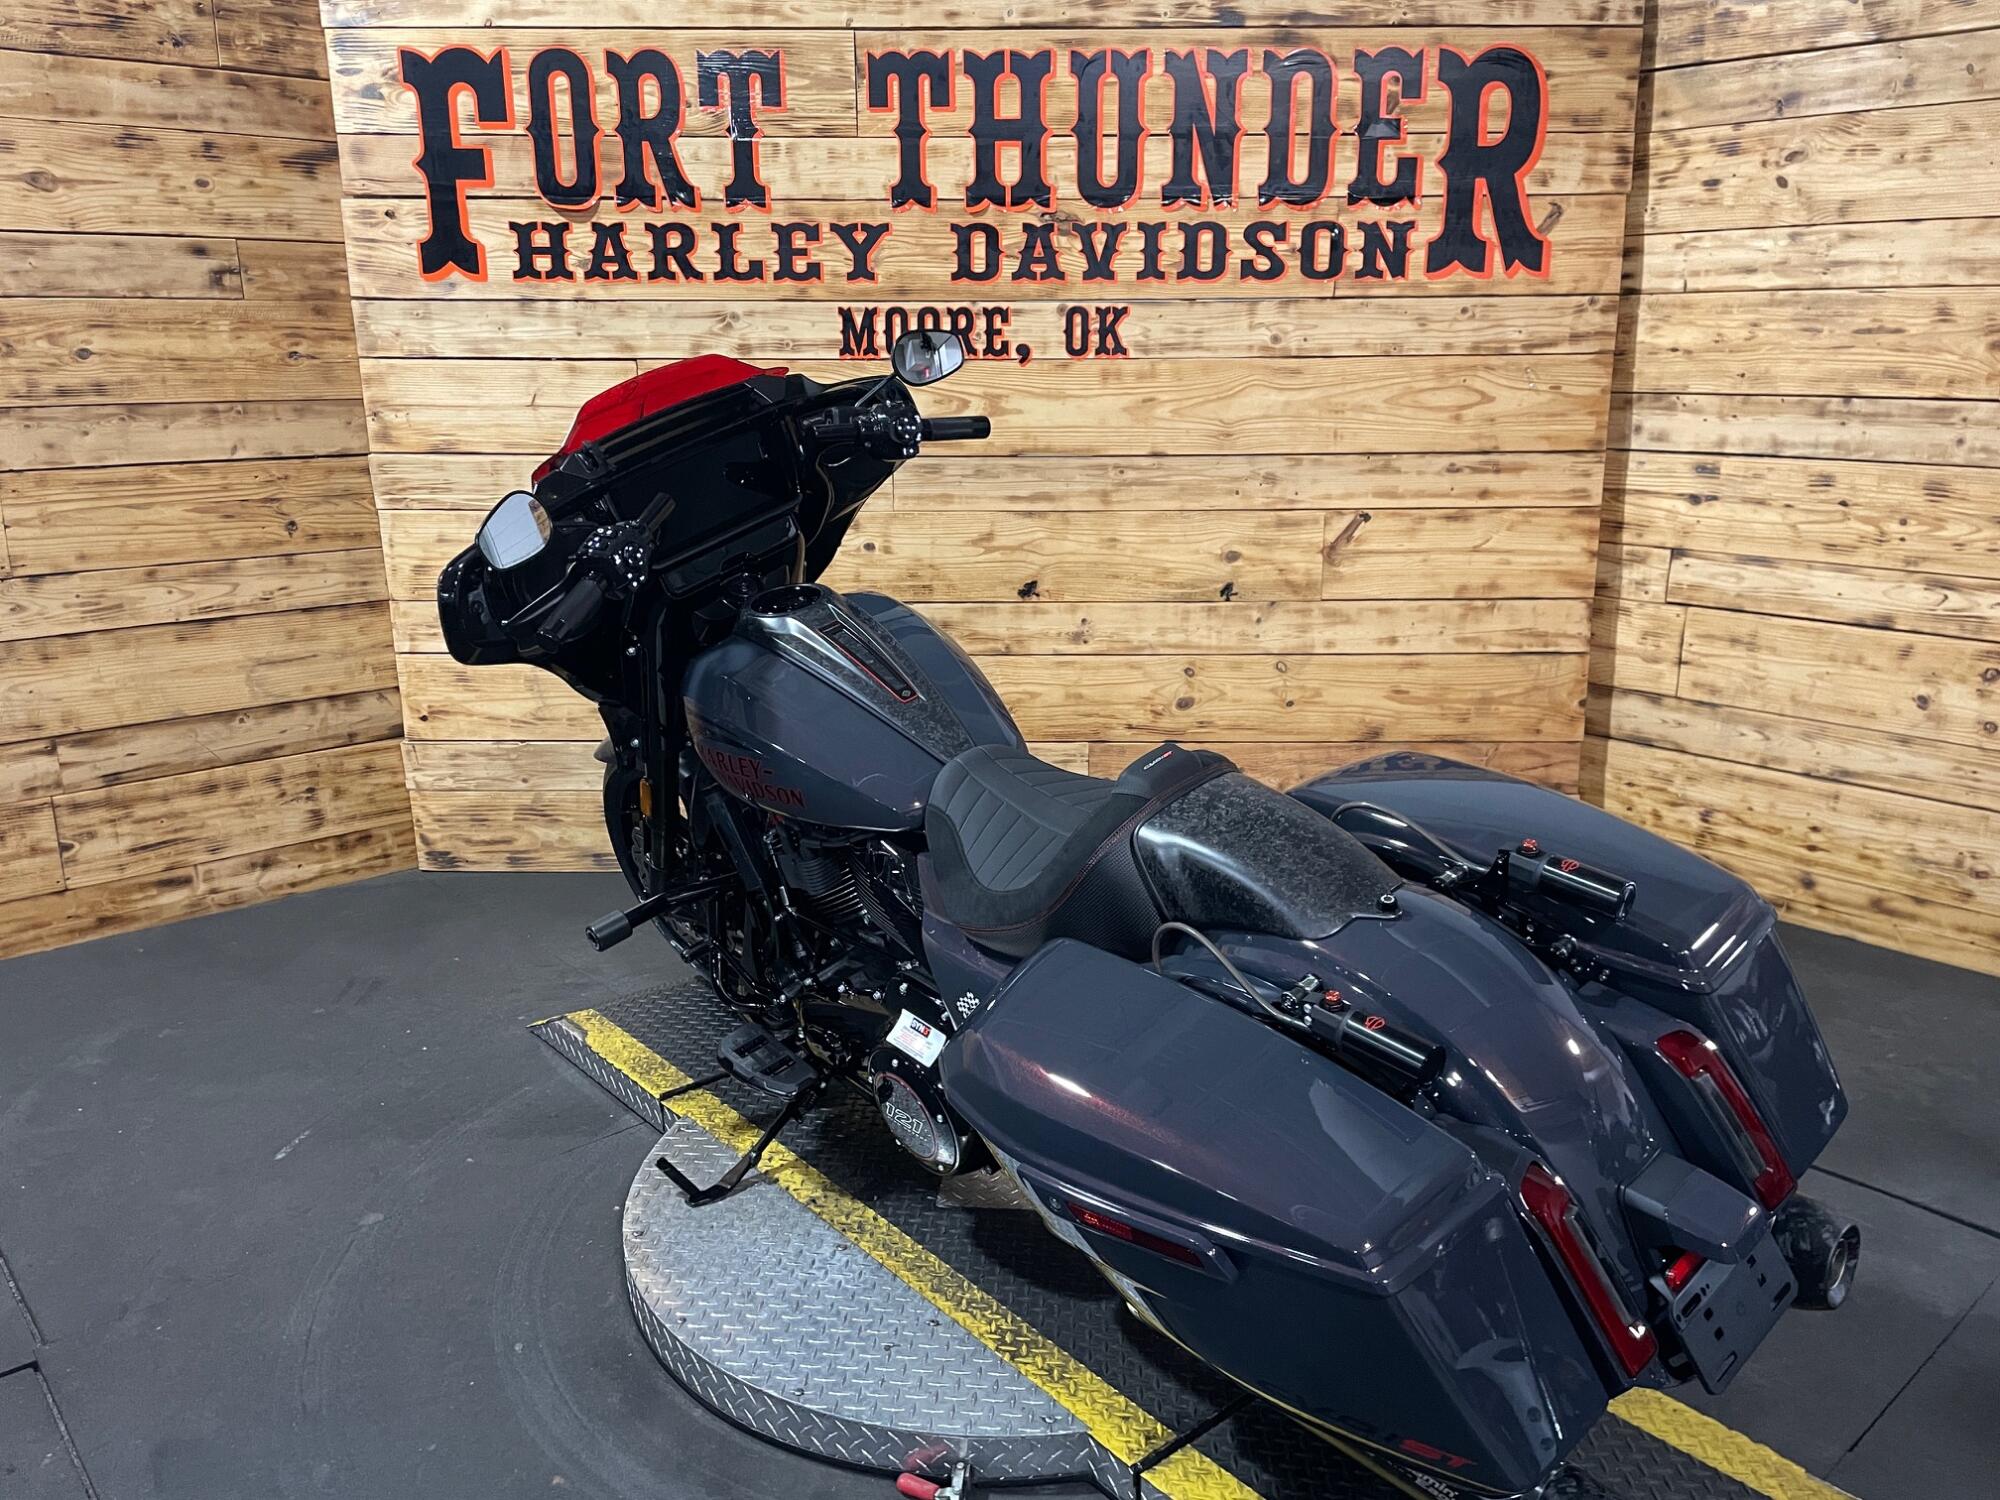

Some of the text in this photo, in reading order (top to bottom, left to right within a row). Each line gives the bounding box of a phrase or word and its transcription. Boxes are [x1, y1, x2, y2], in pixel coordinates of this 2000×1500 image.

[397, 42, 1551, 283] FORT THUNDER
[508, 219, 1420, 284] HARLEY DAVIDSON
[1063, 305, 1131, 361] OK
[885, 1101, 924, 1134] 121
